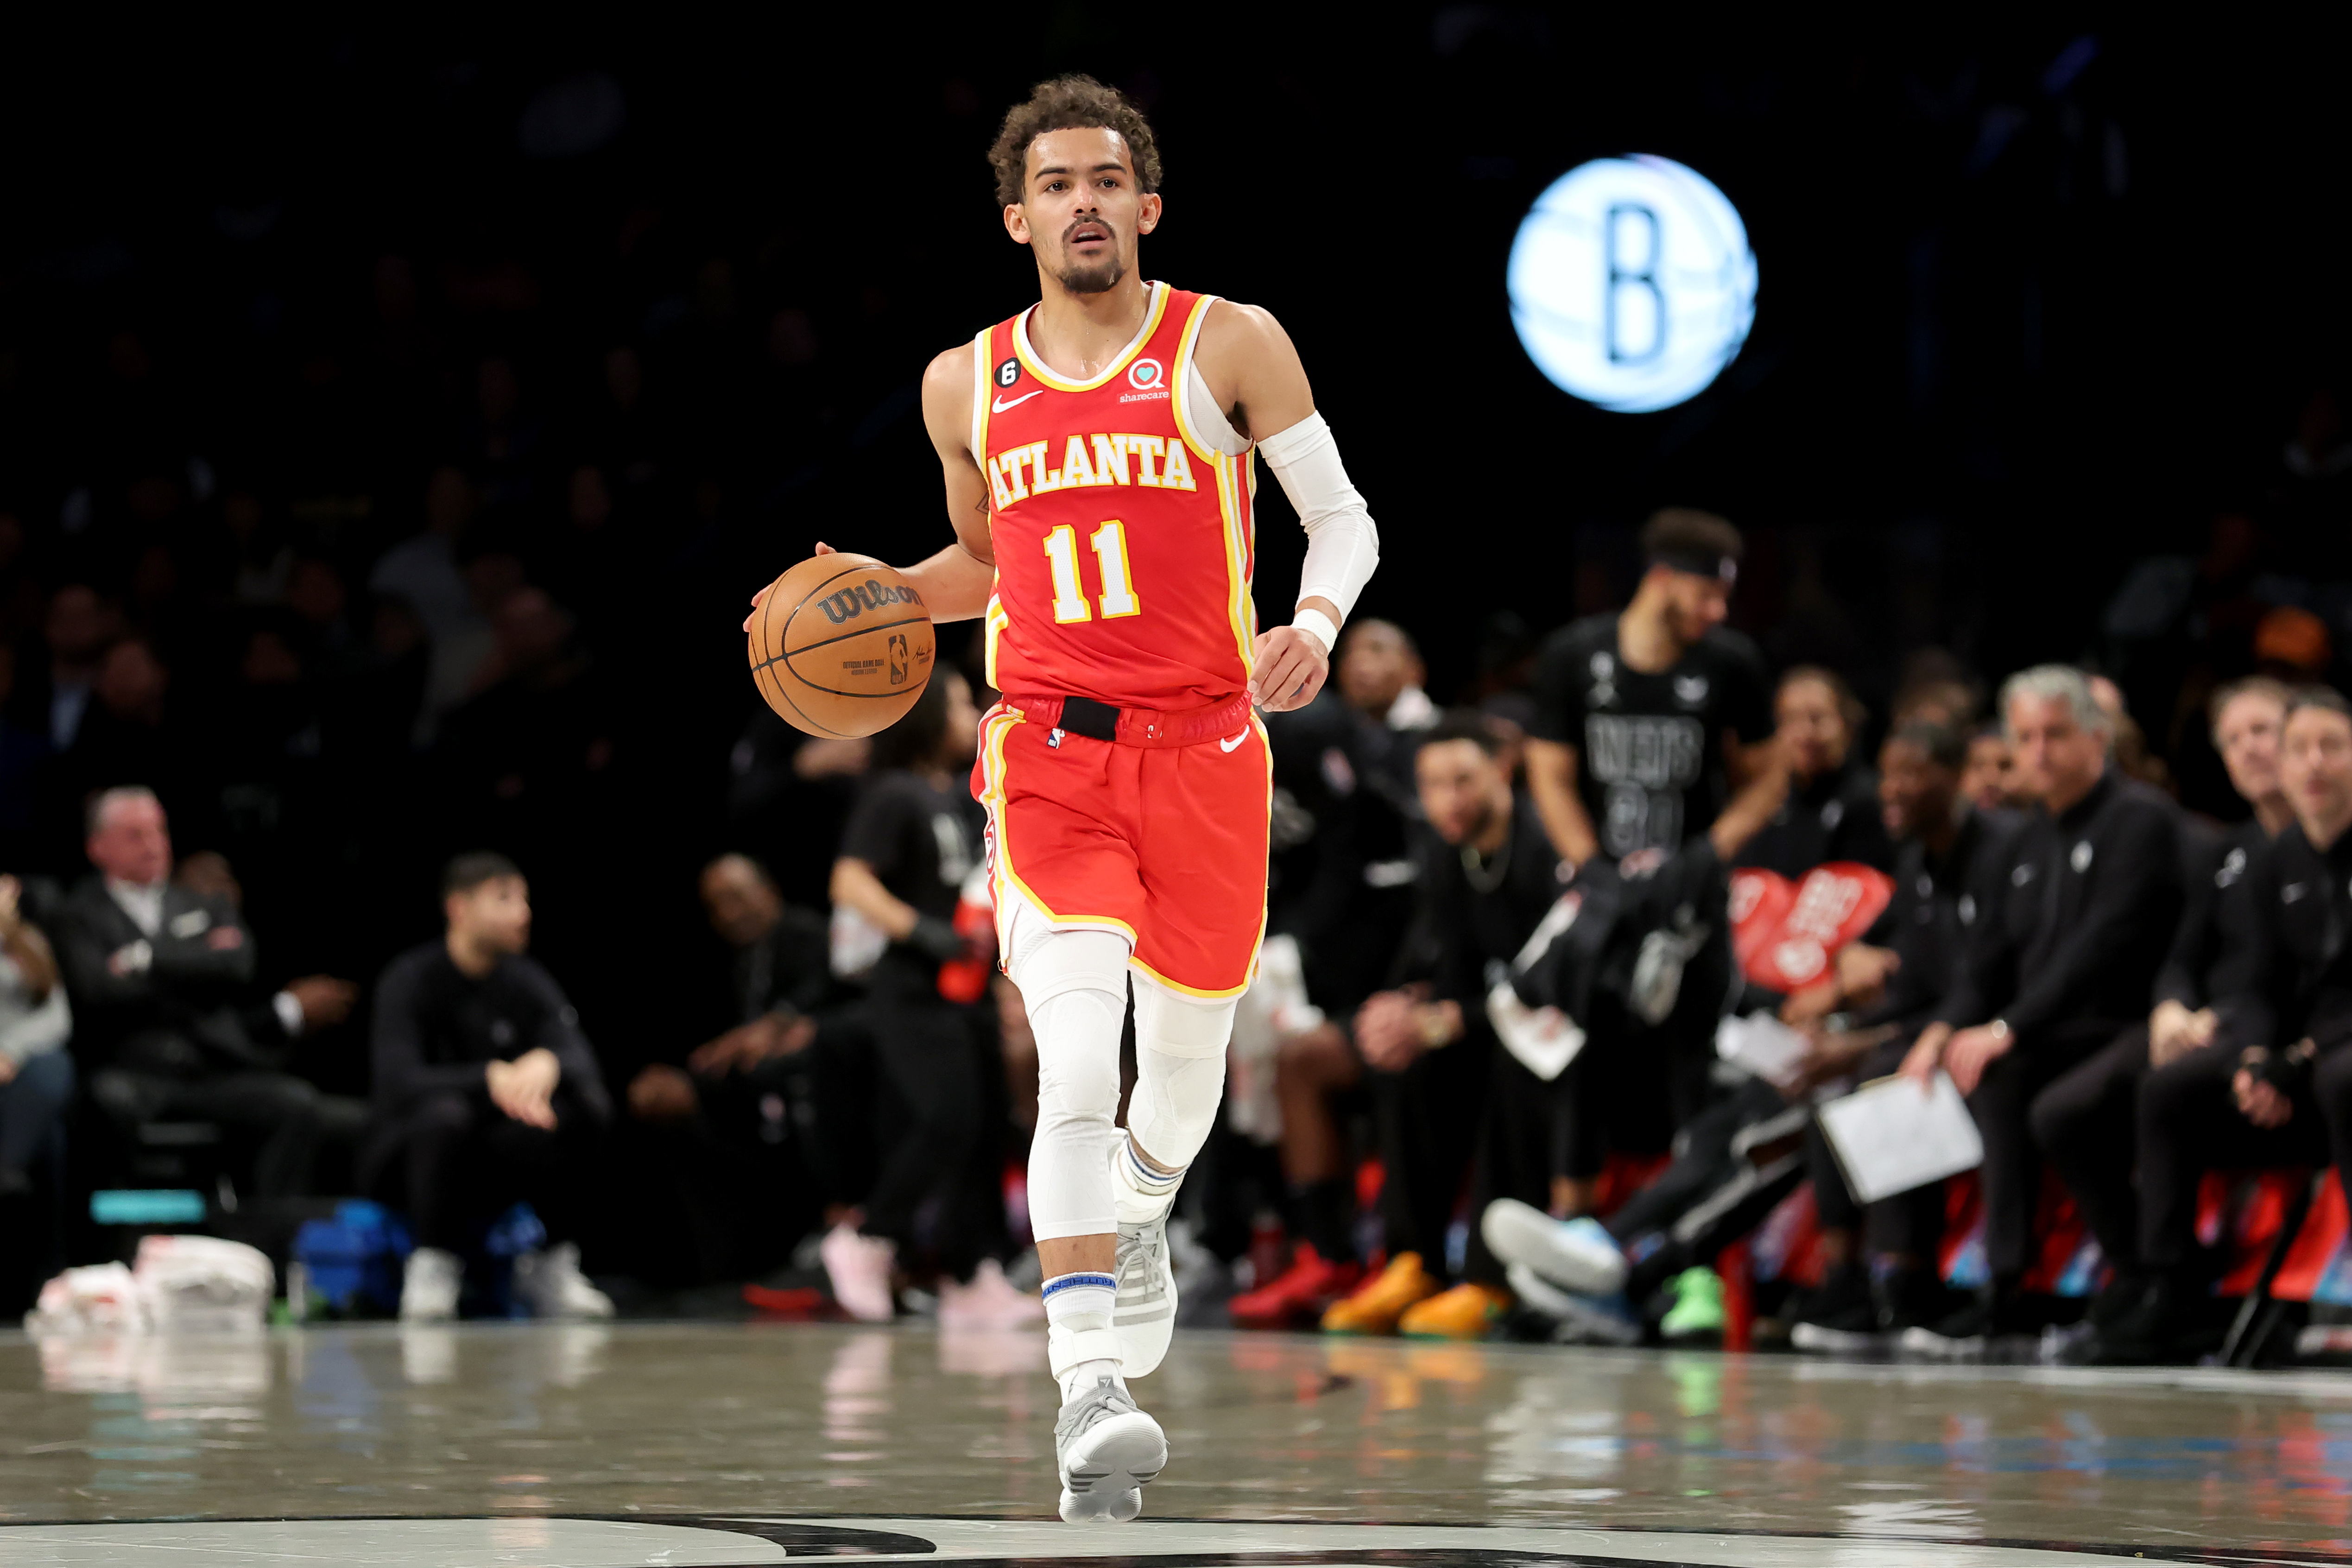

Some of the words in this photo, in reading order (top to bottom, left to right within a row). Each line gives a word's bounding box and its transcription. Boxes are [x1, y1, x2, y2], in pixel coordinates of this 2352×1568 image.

[1606, 202, 1666, 368] B
[1001, 361, 1016, 385] 6
[1119, 391, 1170, 403] sharecare
[987, 433, 1197, 512] ATLANTA
[816, 579, 925, 625] Wilson
[1043, 519, 1141, 624] 11
